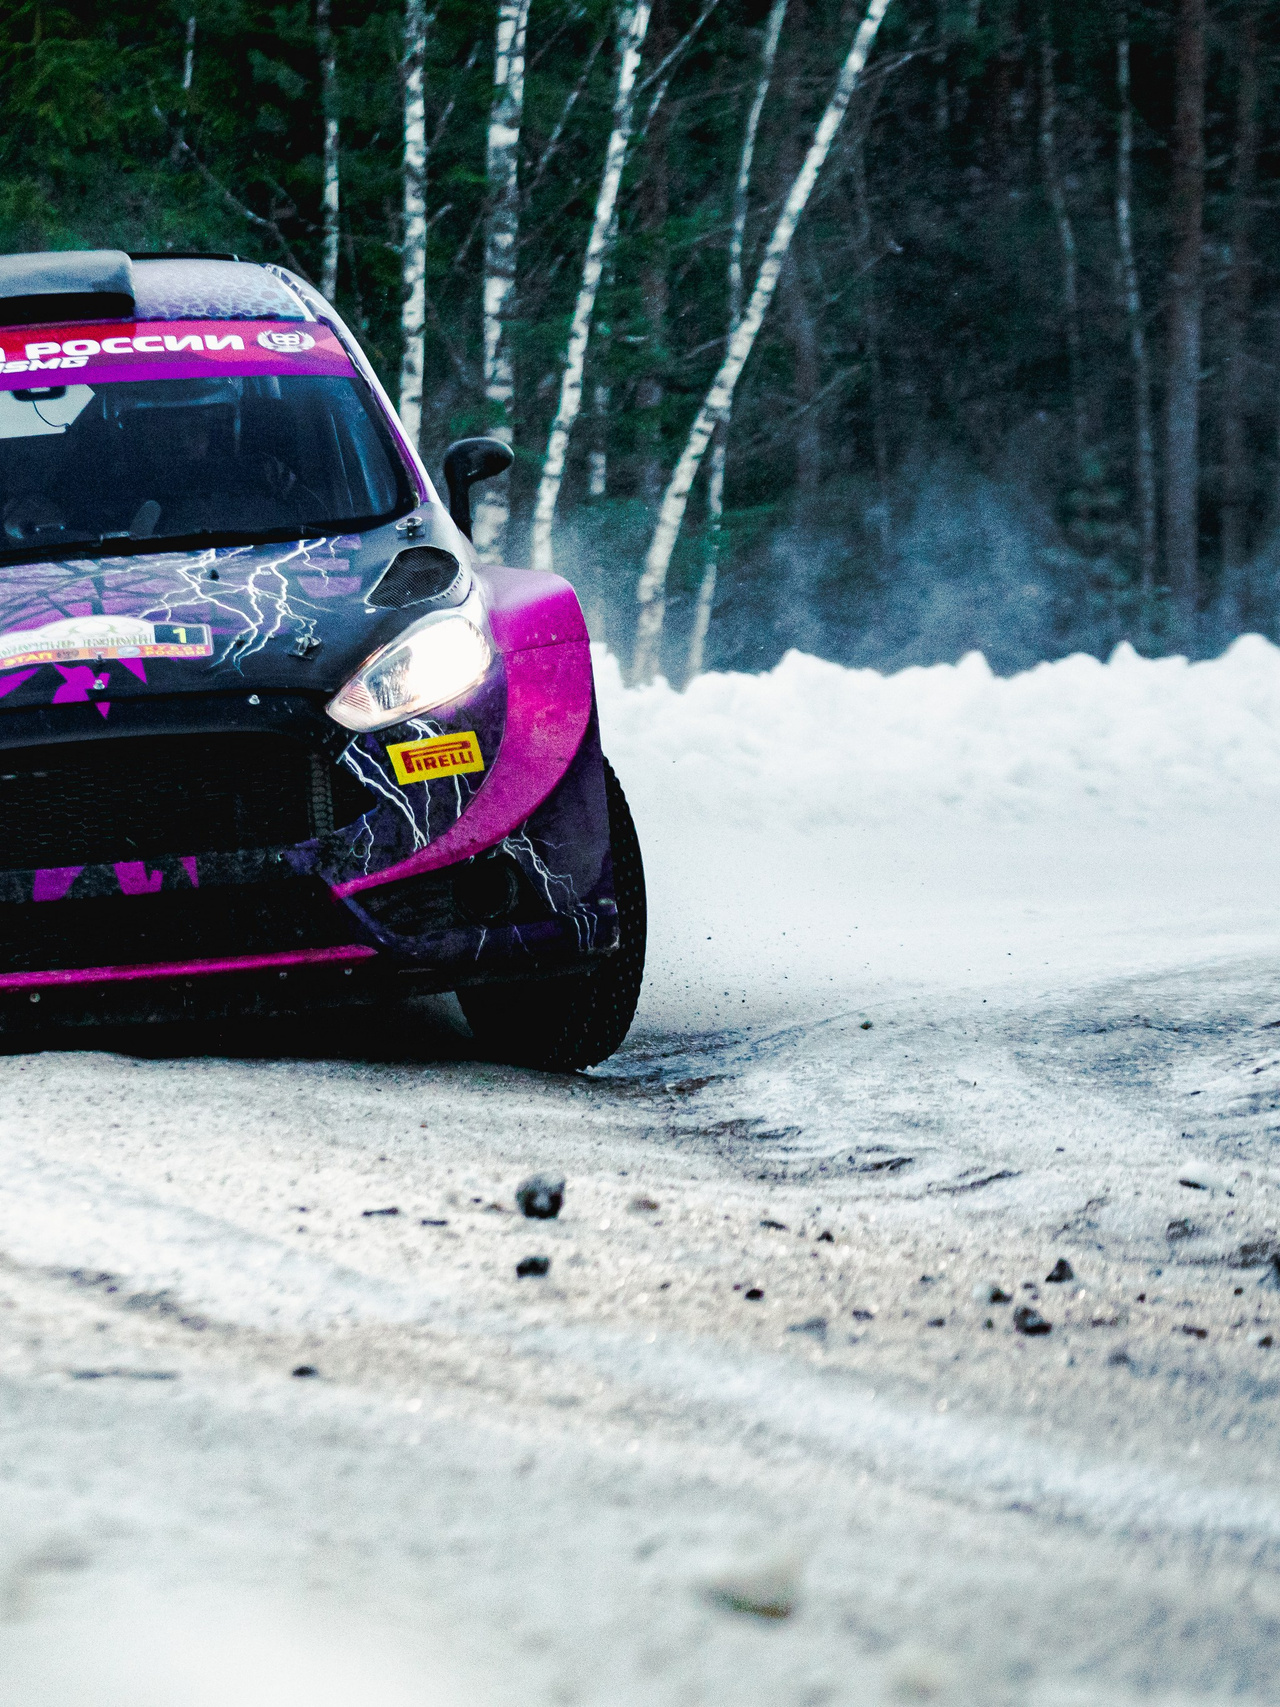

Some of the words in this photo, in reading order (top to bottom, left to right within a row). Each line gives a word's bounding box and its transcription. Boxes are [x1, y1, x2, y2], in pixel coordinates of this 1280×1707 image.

[25, 335, 245, 359] РОССИИ
[172, 627, 187, 643] 1
[4, 652, 52, 666] ЭТАП
[400, 740, 475, 774] PIRELLI
